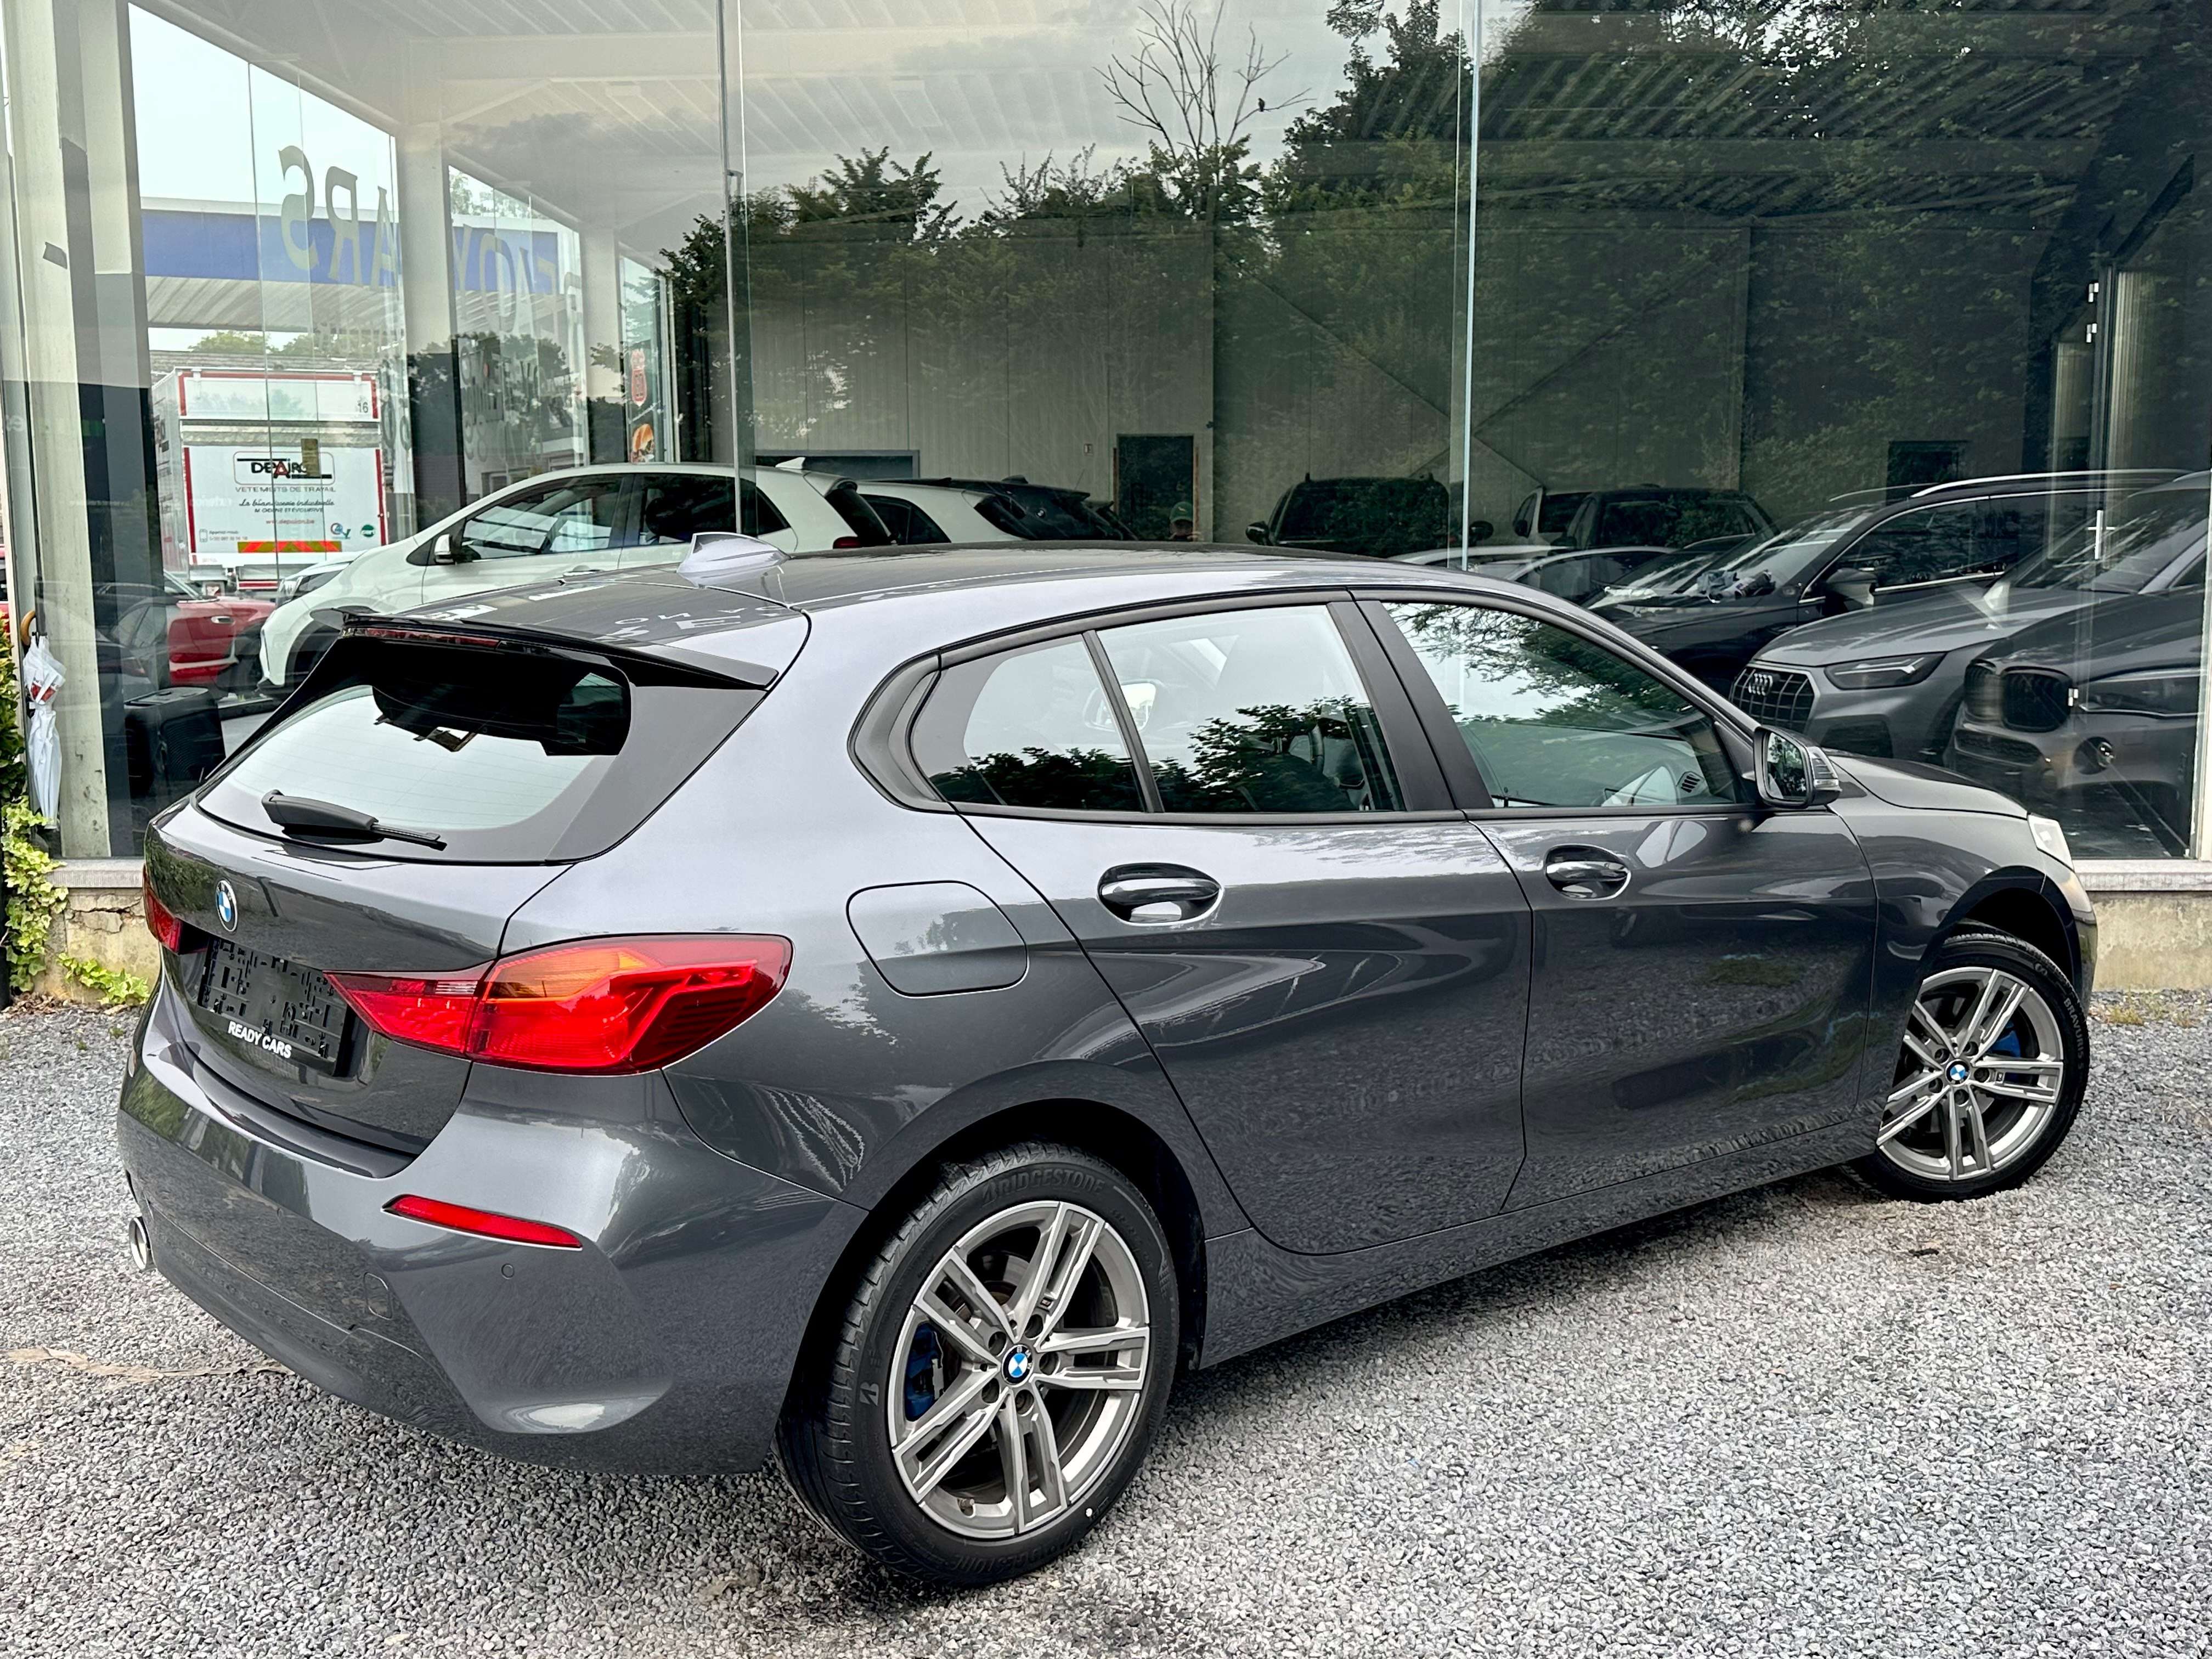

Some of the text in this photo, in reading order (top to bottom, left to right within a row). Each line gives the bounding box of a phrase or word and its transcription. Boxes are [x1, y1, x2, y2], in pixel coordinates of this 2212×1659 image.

[357, 401, 368, 413] 16
[228, 1020, 292, 1058] READY CARS
[982, 1169, 1105, 1207] BRIDGESTONE
